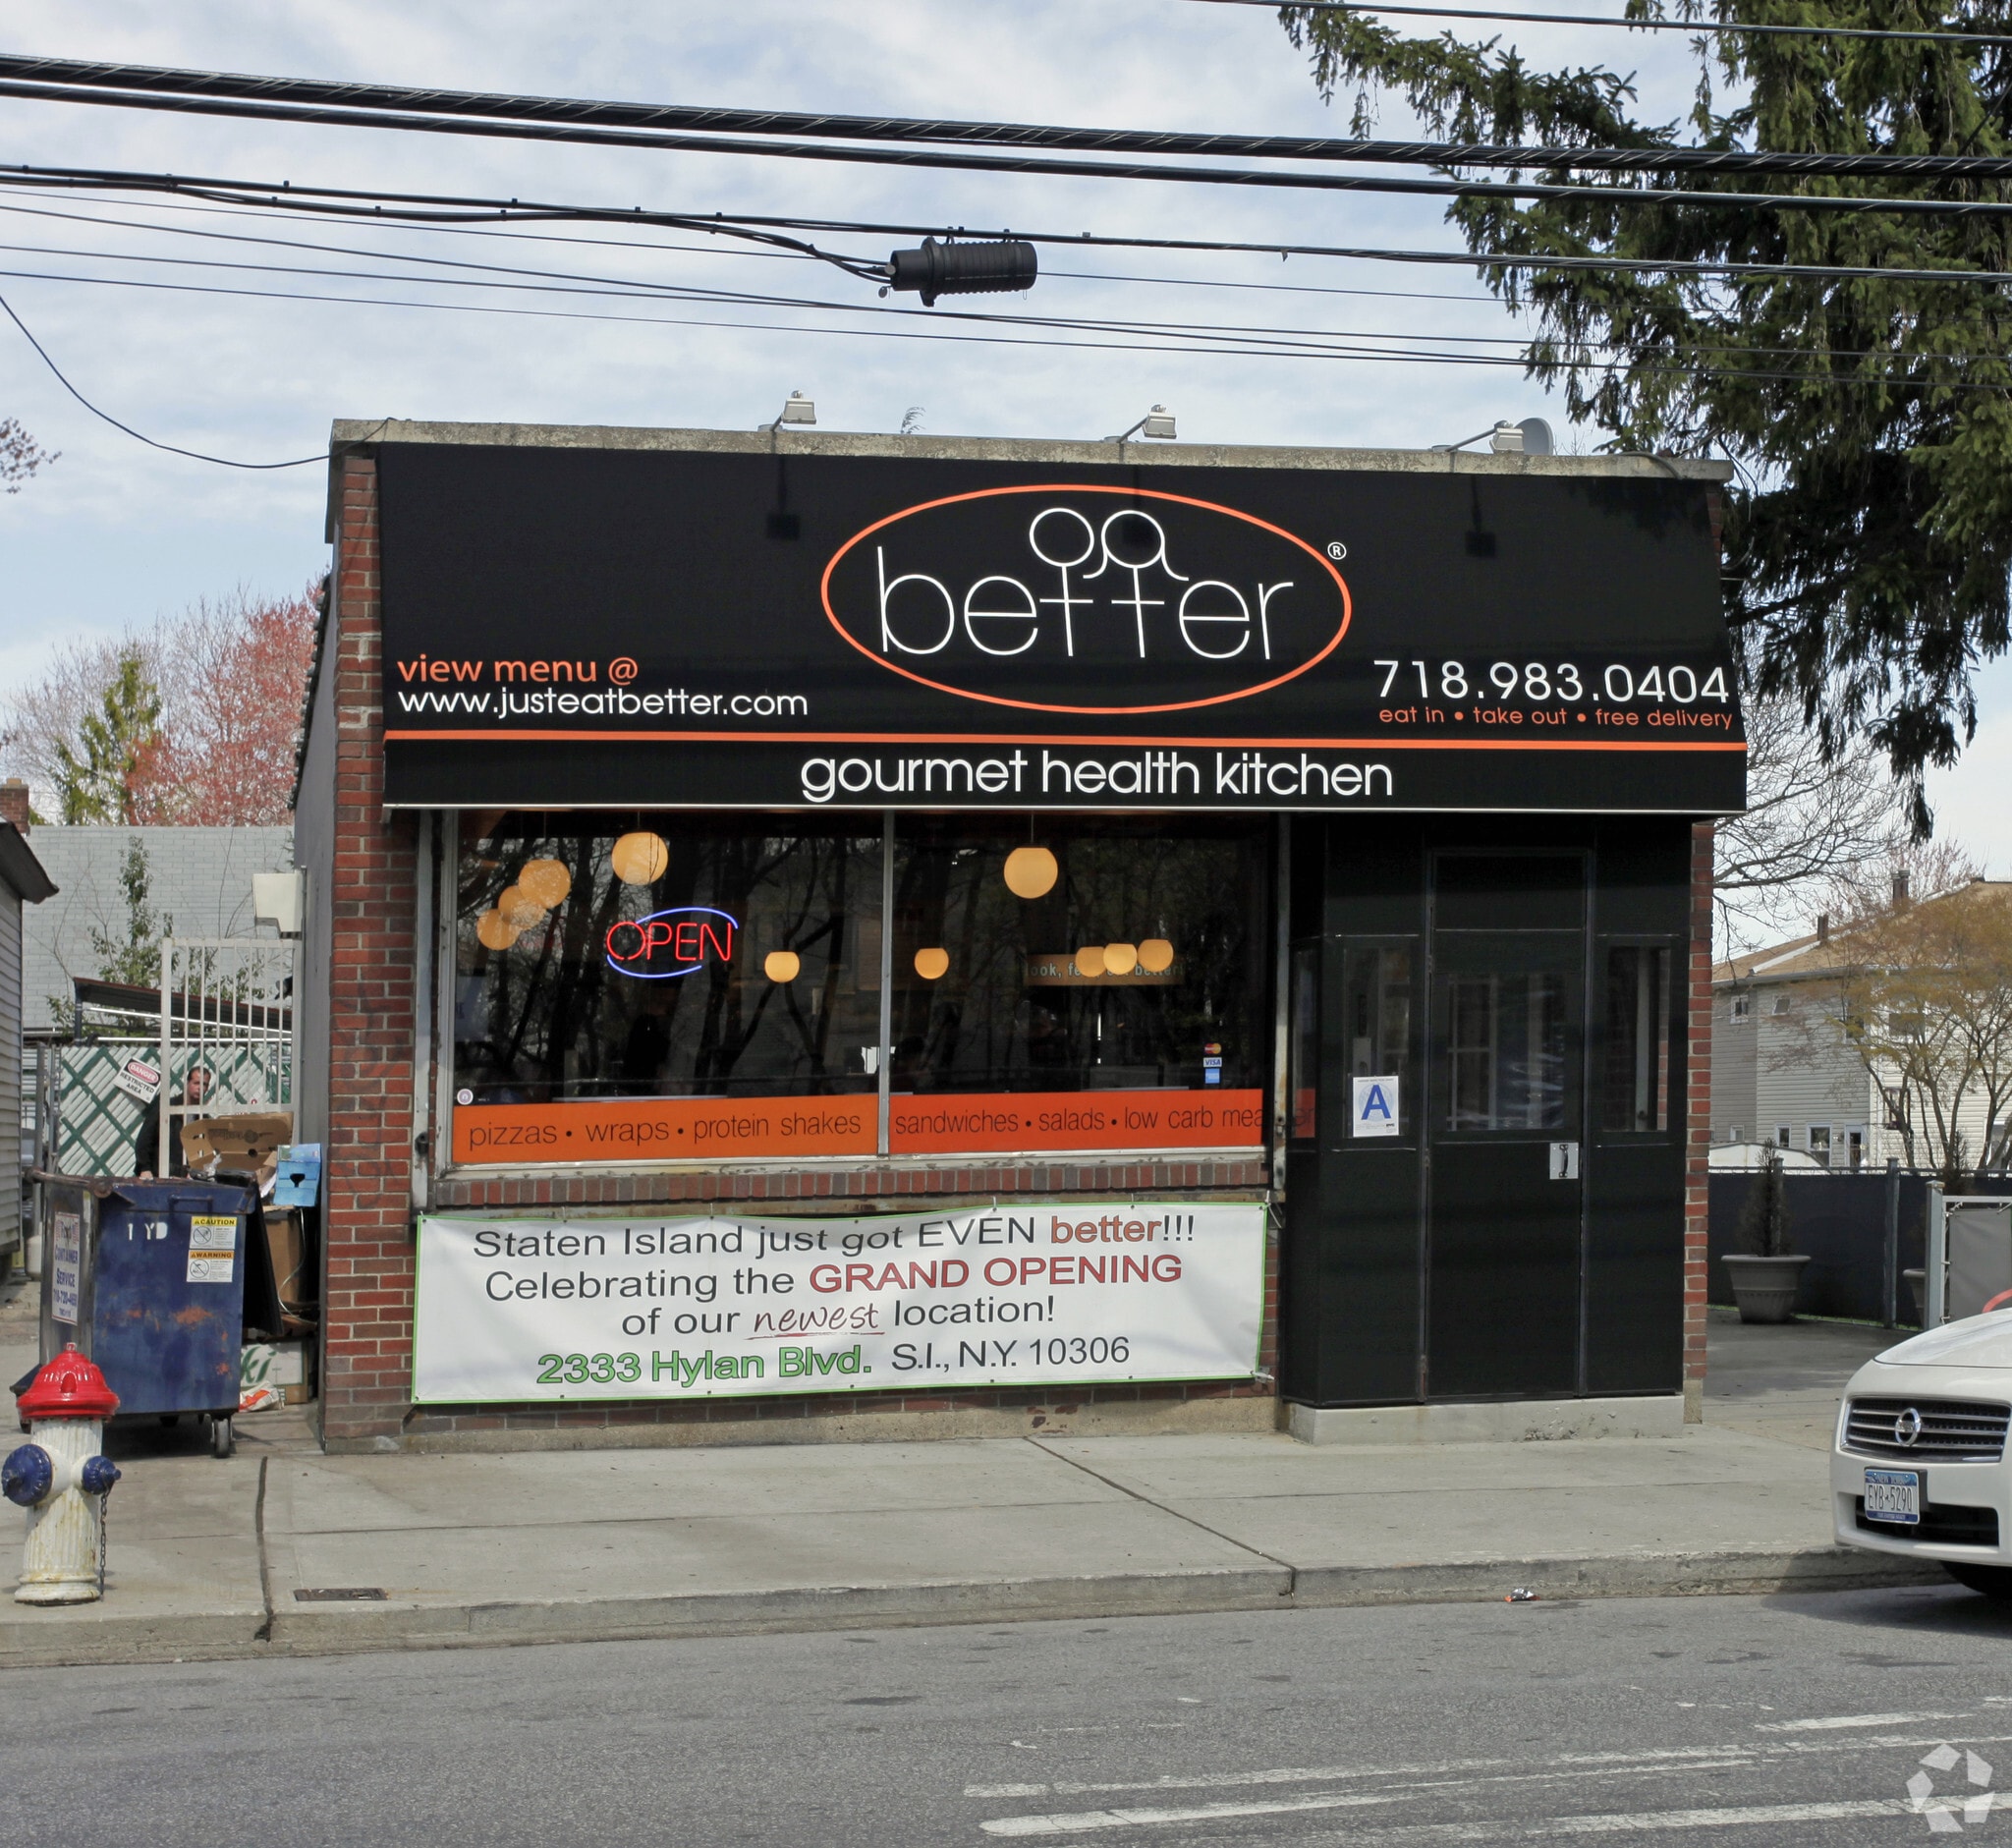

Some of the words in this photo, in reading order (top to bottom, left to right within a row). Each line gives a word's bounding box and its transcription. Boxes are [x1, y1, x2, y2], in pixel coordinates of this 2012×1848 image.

[876, 507, 1295, 660] better
[396, 653, 483, 683] view
[494, 660, 597, 683] menu
[607, 656, 639, 686] @
[1373, 660, 1729, 703] 718.983.0404
[398, 687, 808, 719] www.justeatbetter.com
[1378, 706, 1418, 723] eat
[1425, 706, 1444, 723] in
[1473, 706, 1524, 724] take
[1531, 707, 1567, 725] out
[1594, 708, 1640, 726] free
[1647, 709, 1733, 730] delivery
[801, 750, 1028, 803] gourmet
[1042, 750, 1200, 794] health
[1215, 753, 1393, 796] kitchen
[606, 920, 733, 962] OPEN
[894, 1109, 1019, 1135] sandwiches
[1038, 1107, 1105, 1132] salads
[1124, 1106, 1158, 1130] low
[1168, 1104, 1214, 1129] carb
[1361, 1084, 1392, 1121] A
[469, 1122, 558, 1151] pizzas
[586, 1119, 669, 1147] wraps
[694, 1112, 770, 1144] protein
[780, 1110, 862, 1136] shakes
[127, 1222, 134, 1241] 1
[474, 1229, 606, 1258] Staten
[624, 1226, 744, 1256] Island
[755, 1226, 828, 1260] just
[841, 1226, 903, 1258] got
[919, 1216, 1035, 1248] EVEN
[1050, 1214, 1194, 1244] better!!!
[485, 1267, 718, 1303] Celebrating
[733, 1267, 795, 1294] the
[810, 1259, 971, 1294] GRAND
[983, 1254, 1183, 1287] OPENING
[622, 1307, 662, 1335] of
[674, 1311, 741, 1333] our
[753, 1303, 879, 1334] newest
[894, 1295, 1055, 1326] location!
[536, 1352, 642, 1384] 2333
[651, 1349, 764, 1388] Hylan
[778, 1344, 872, 1378] Blvd.
[891, 1342, 950, 1372] S.I.,
[959, 1339, 1018, 1368] N.Y.
[1029, 1335, 1131, 1366] 10306
